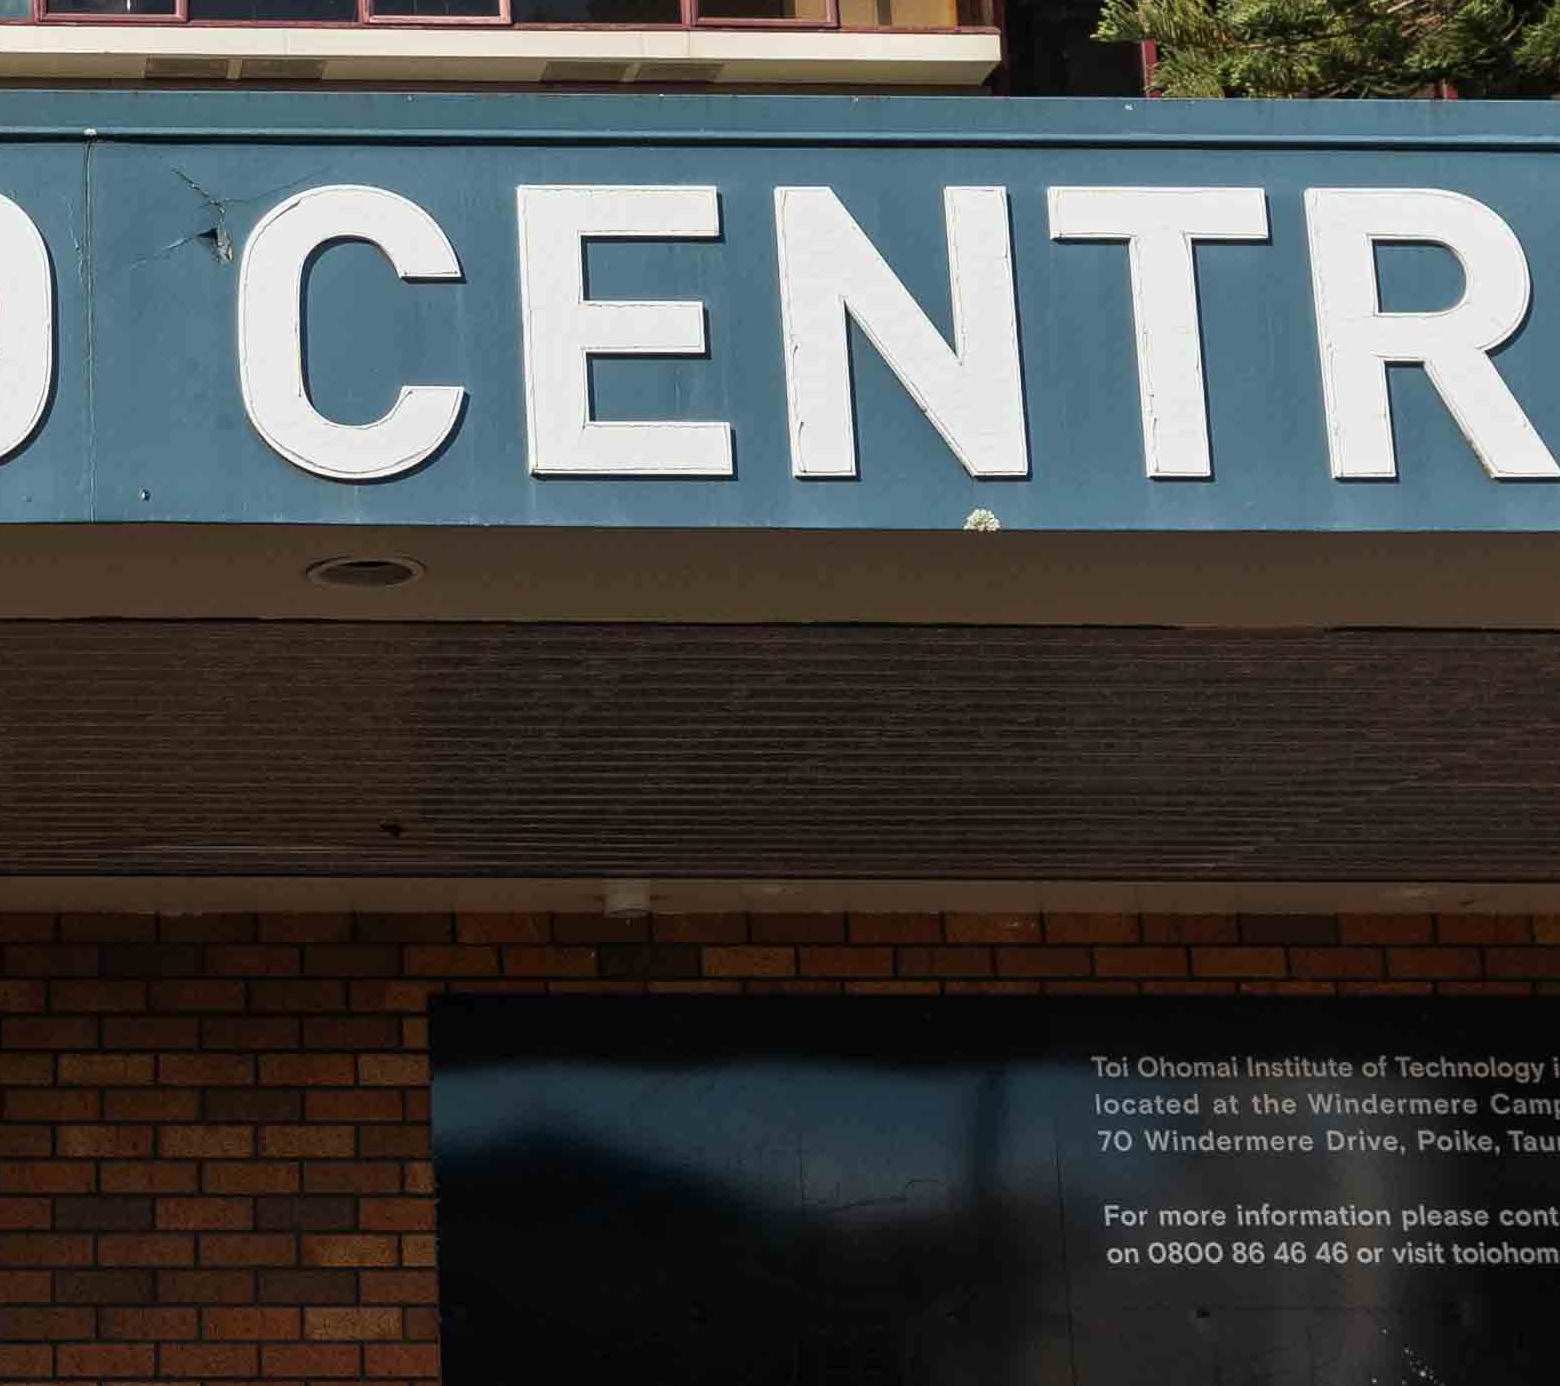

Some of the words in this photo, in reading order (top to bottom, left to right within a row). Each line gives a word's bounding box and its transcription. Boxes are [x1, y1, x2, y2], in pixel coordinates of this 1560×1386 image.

[1091, 1056, 1129, 1079] Toi
[1137, 1056, 1238, 1079] Ohomai
[1247, 1056, 1353, 1079] Institute
[1361, 1055, 1387, 1079] of
[1394, 1056, 1544, 1083] Technology
[1095, 1093, 1200, 1116] located
[1212, 1095, 1240, 1116] at
[1251, 1093, 1297, 1116] the
[1306, 1093, 1477, 1116] Windermere
[1097, 1129, 1133, 1152] 70
[1143, 1129, 1314, 1152] Windermere
[1325, 1128, 1406, 1156] Drive,
[1417, 1129, 1501, 1155] Poike,
[1104, 1204, 1149, 1227] For
[1158, 1209, 1227, 1227] more
[1235, 1202, 1392, 1227] information
[1401, 1204, 1489, 1231] please
[1106, 1247, 1140, 1265] on
[1147, 1241, 1224, 1265] 0800
[1231, 1241, 1266, 1265] 86
[1273, 1241, 1307, 1265] 46
[1314, 1241, 1349, 1265] 46
[1356, 1246, 1384, 1265] or
[1391, 1241, 1446, 1265] visit
